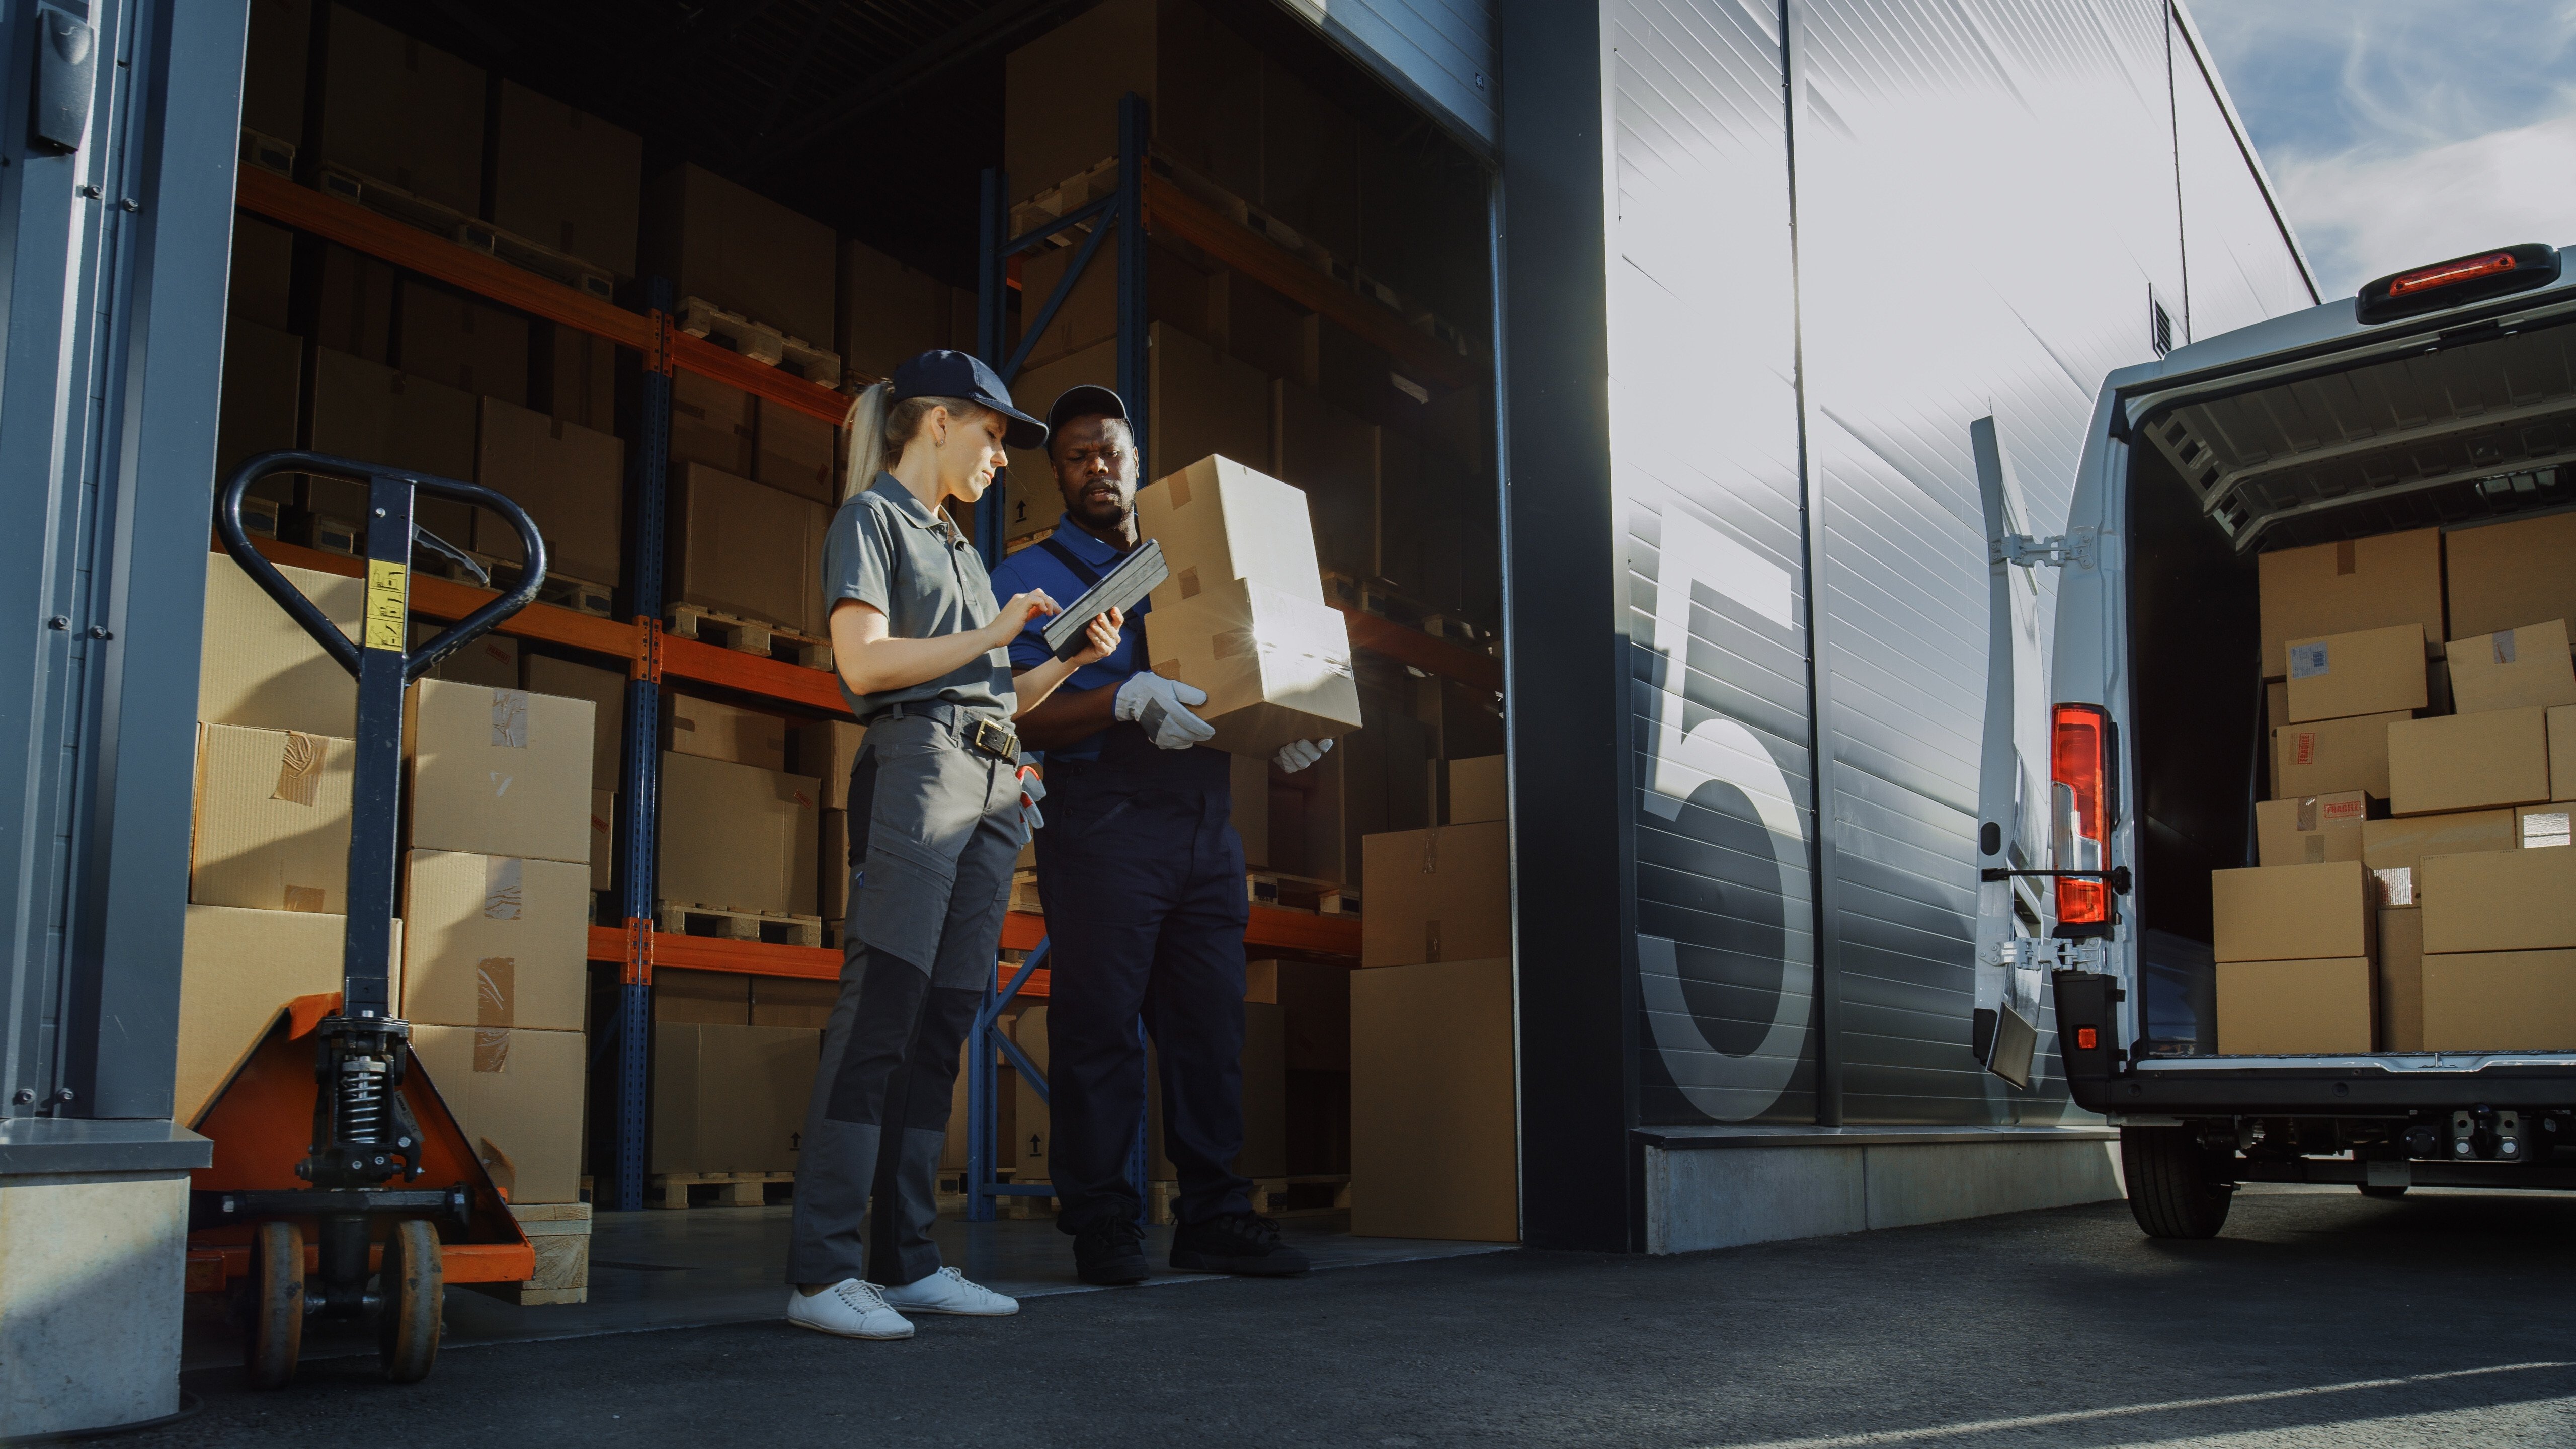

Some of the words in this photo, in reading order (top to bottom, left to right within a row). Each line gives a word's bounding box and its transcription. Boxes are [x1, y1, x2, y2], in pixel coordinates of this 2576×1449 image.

[2300, 735, 2310, 762] FRAGILE
[1637, 501, 1815, 1122] 5
[2327, 803, 2359, 814] FRAGILE
